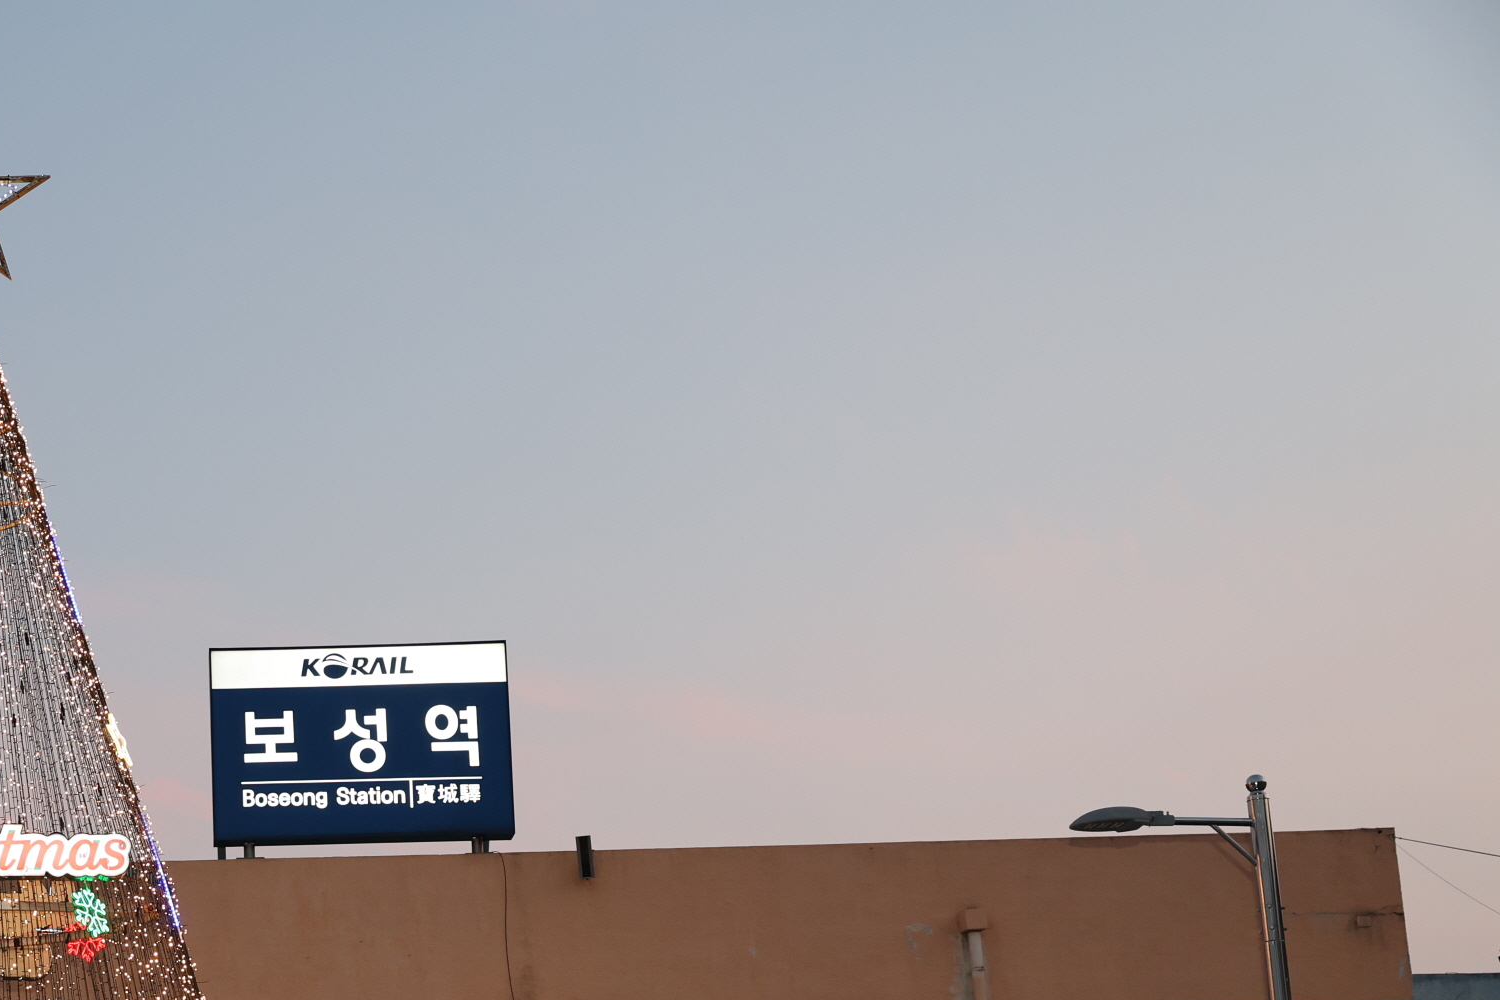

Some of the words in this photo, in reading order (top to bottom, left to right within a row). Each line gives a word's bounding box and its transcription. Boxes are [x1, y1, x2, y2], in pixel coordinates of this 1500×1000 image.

[301, 653, 414, 679] KORAIL
[243, 704, 481, 773] 보성역
[241, 788, 328, 809] Boseong
[336, 786, 407, 806] Station
